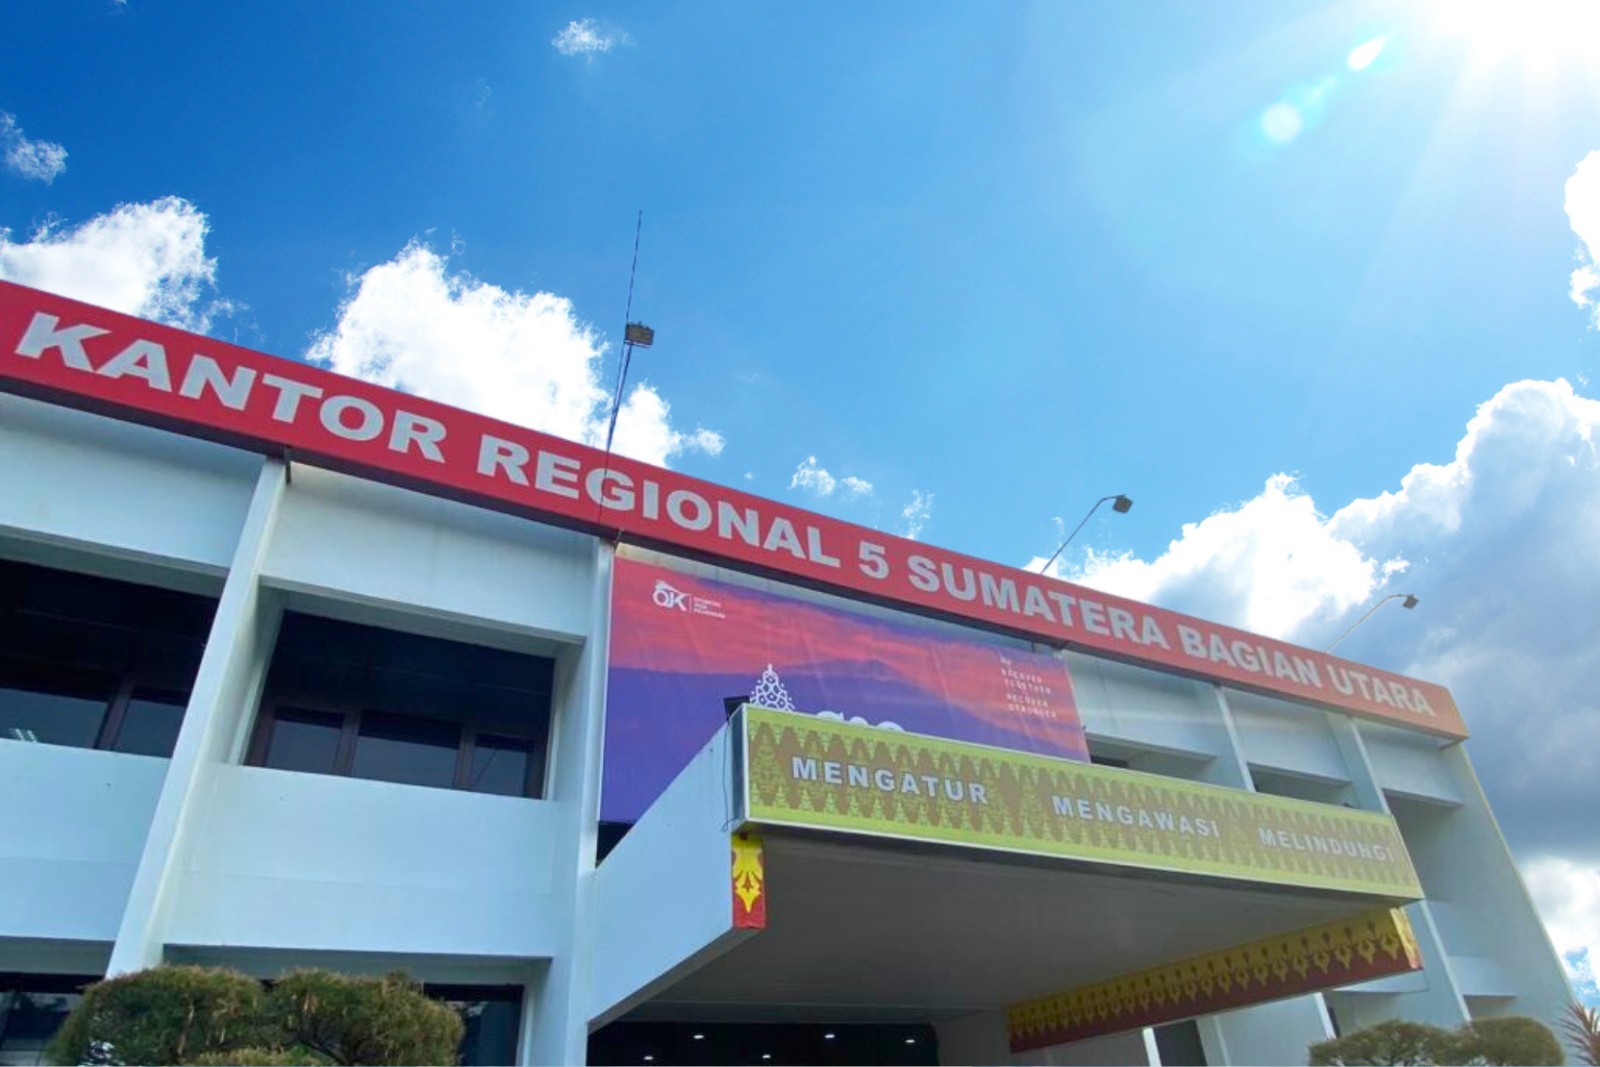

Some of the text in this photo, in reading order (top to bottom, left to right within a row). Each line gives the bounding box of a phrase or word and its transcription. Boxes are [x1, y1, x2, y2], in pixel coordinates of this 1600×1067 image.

[15, 311, 1436, 717] KANTOR REGIONAL 5 SUMATERA BAGIAN UTARA
[652, 585, 692, 612] OJK
[792, 757, 1395, 863] MENGATUR MENGAWASI MELINDUNGI
